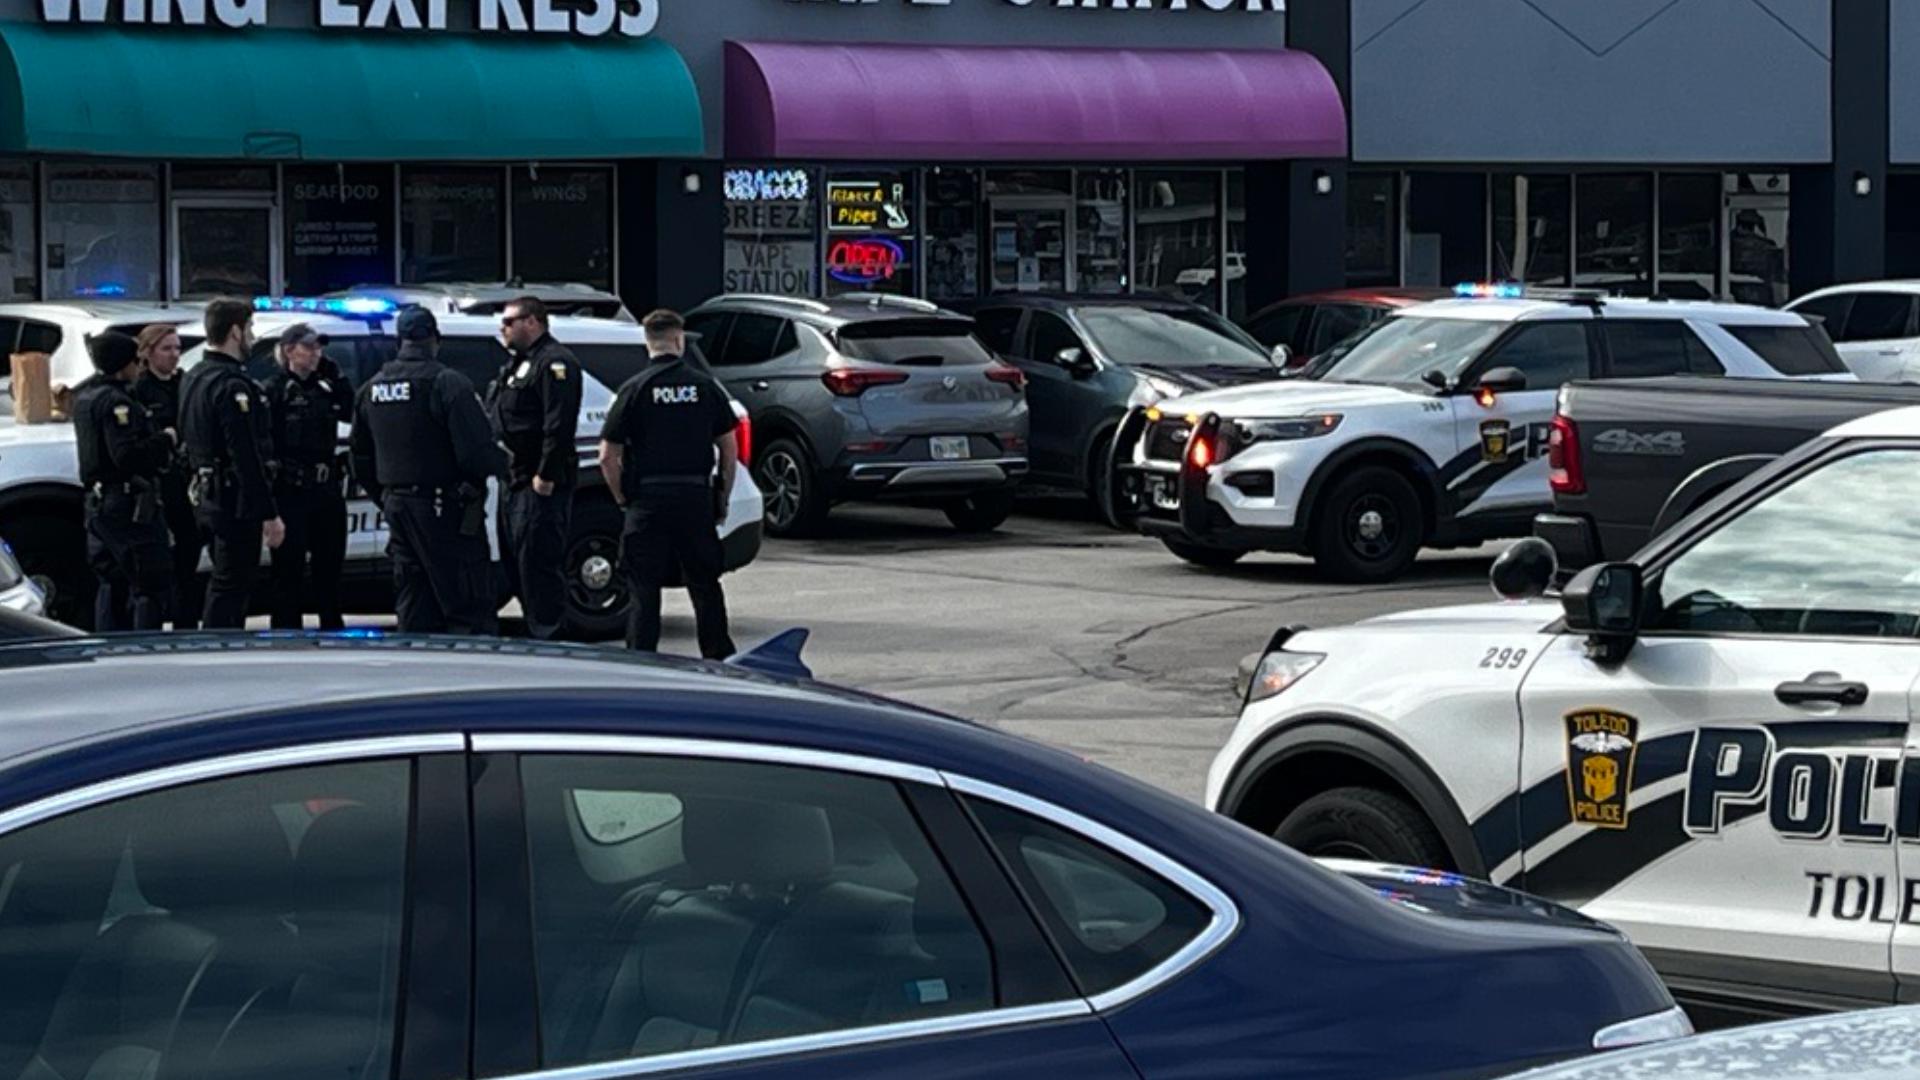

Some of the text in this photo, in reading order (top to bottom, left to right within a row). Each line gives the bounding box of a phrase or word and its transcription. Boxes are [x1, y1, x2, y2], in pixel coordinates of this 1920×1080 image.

[294, 184, 379, 200] SEAFOOD
[531, 185, 588, 201] WINGS
[838, 208, 878, 225] Pipes
[741, 245, 793, 269] VAPE
[829, 241, 897, 280] OPEN
[726, 269, 809, 294] STATION
[371, 382, 411, 403] POLICE
[652, 385, 699, 405] POLICE
[1594, 428, 1686, 449] 4x4
[1479, 647, 1528, 670] 299
[1573, 712, 1630, 736] TOLEDO
[1576, 802, 1622, 822] POLICE
